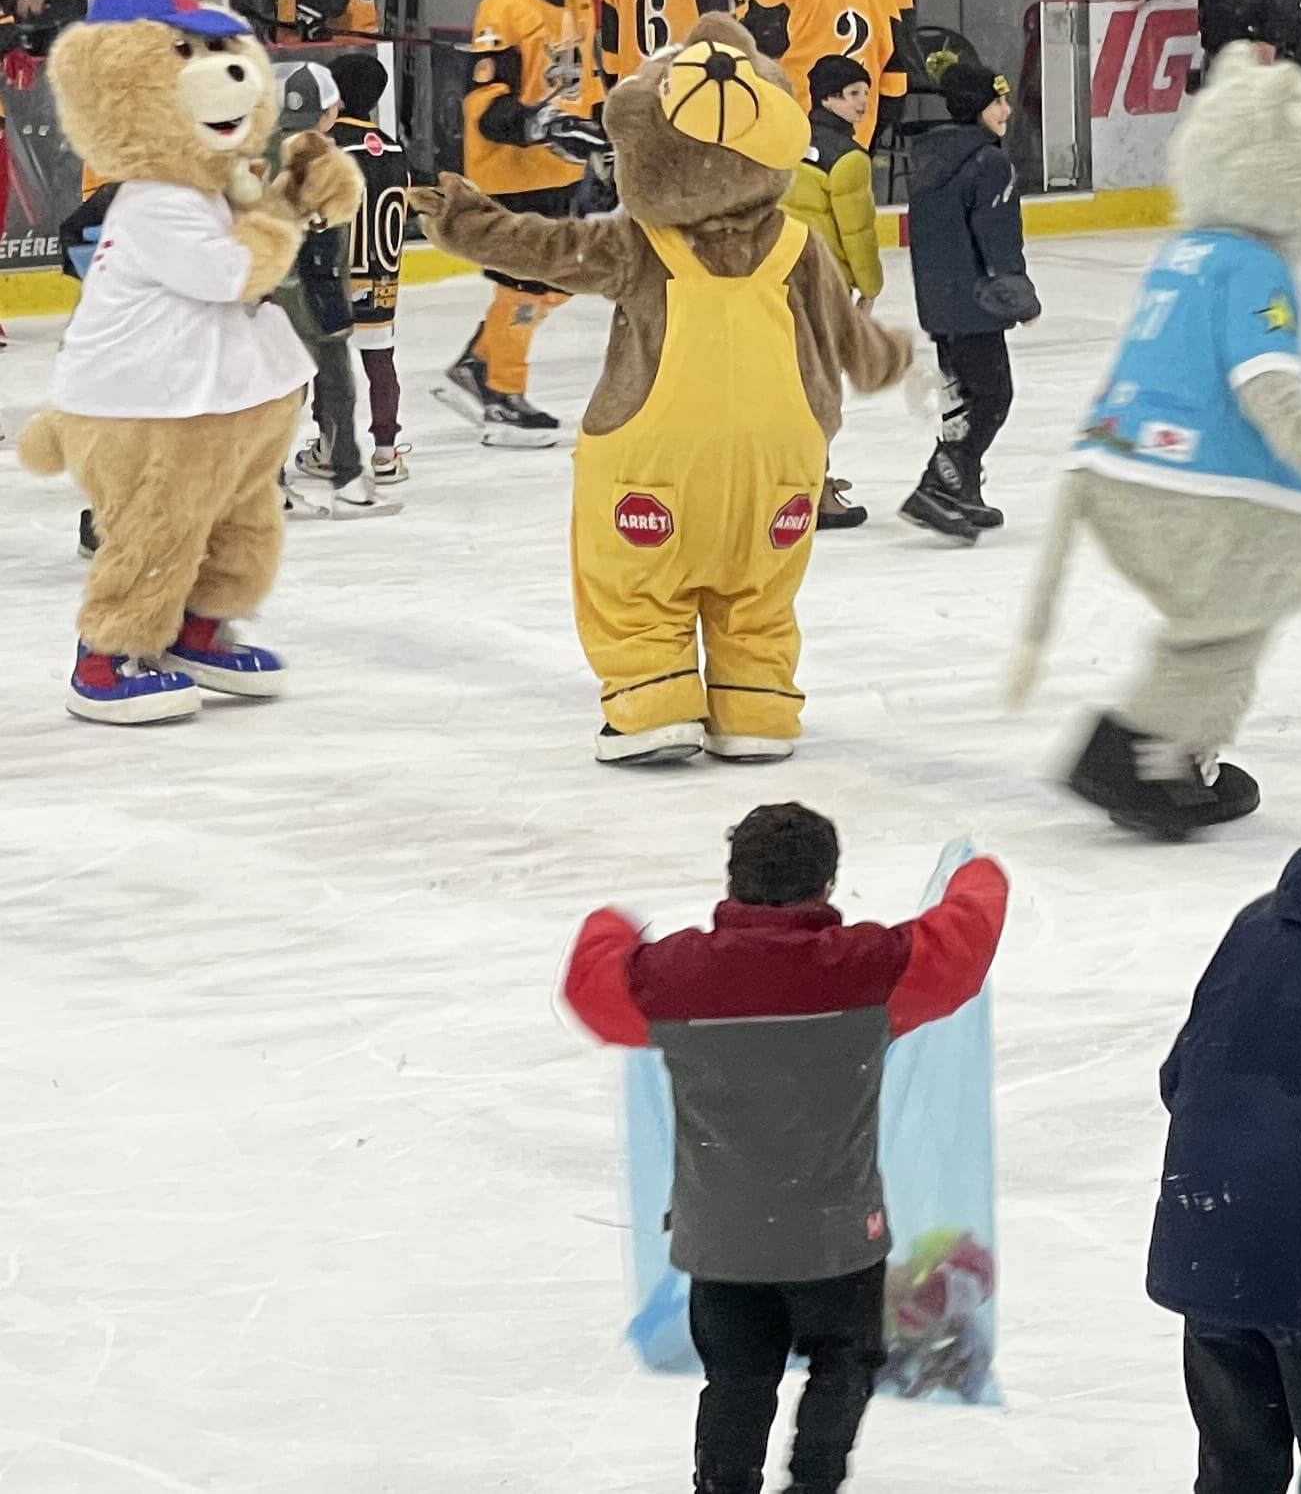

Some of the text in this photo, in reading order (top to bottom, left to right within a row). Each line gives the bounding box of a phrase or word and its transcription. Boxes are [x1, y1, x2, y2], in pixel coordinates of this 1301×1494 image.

[1089, 7, 1201, 118] IG
[0, 229, 58, 261] ÉFÉRE
[349, 186, 407, 274] 10
[619, 511, 668, 532] ARRÊT
